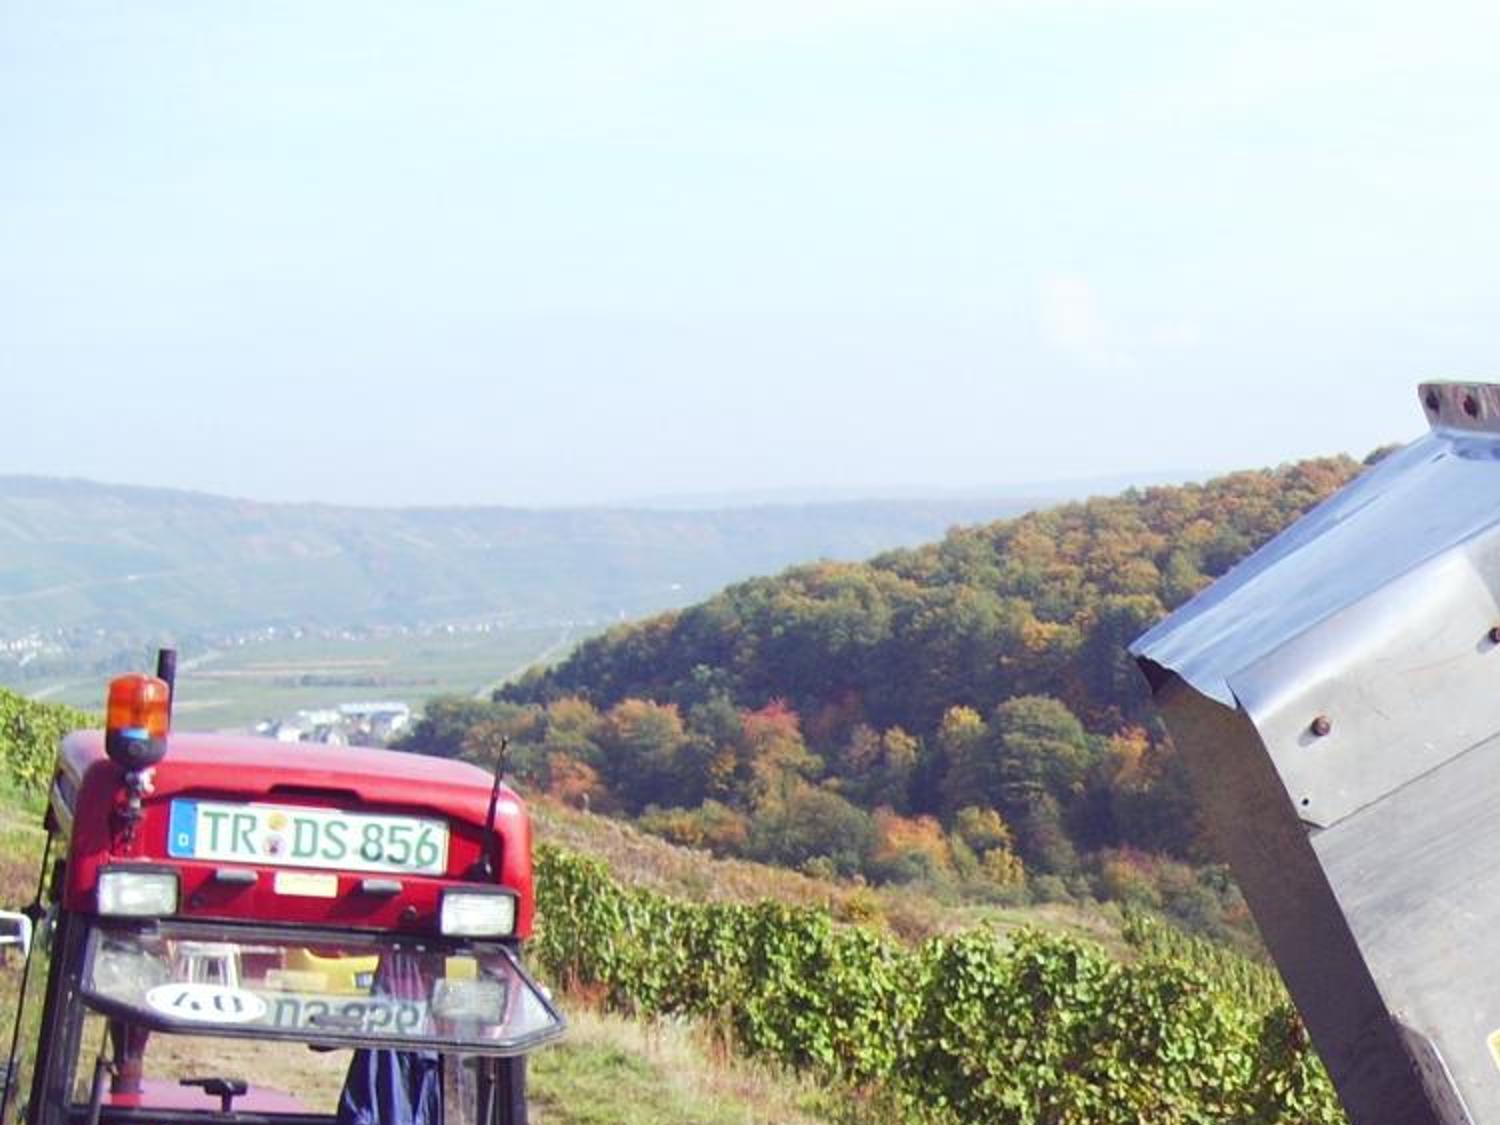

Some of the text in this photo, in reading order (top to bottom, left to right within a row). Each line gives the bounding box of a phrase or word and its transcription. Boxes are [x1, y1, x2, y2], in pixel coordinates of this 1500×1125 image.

[203, 811, 256, 854] TR
[291, 817, 348, 860] DS
[360, 823, 439, 868] 856
